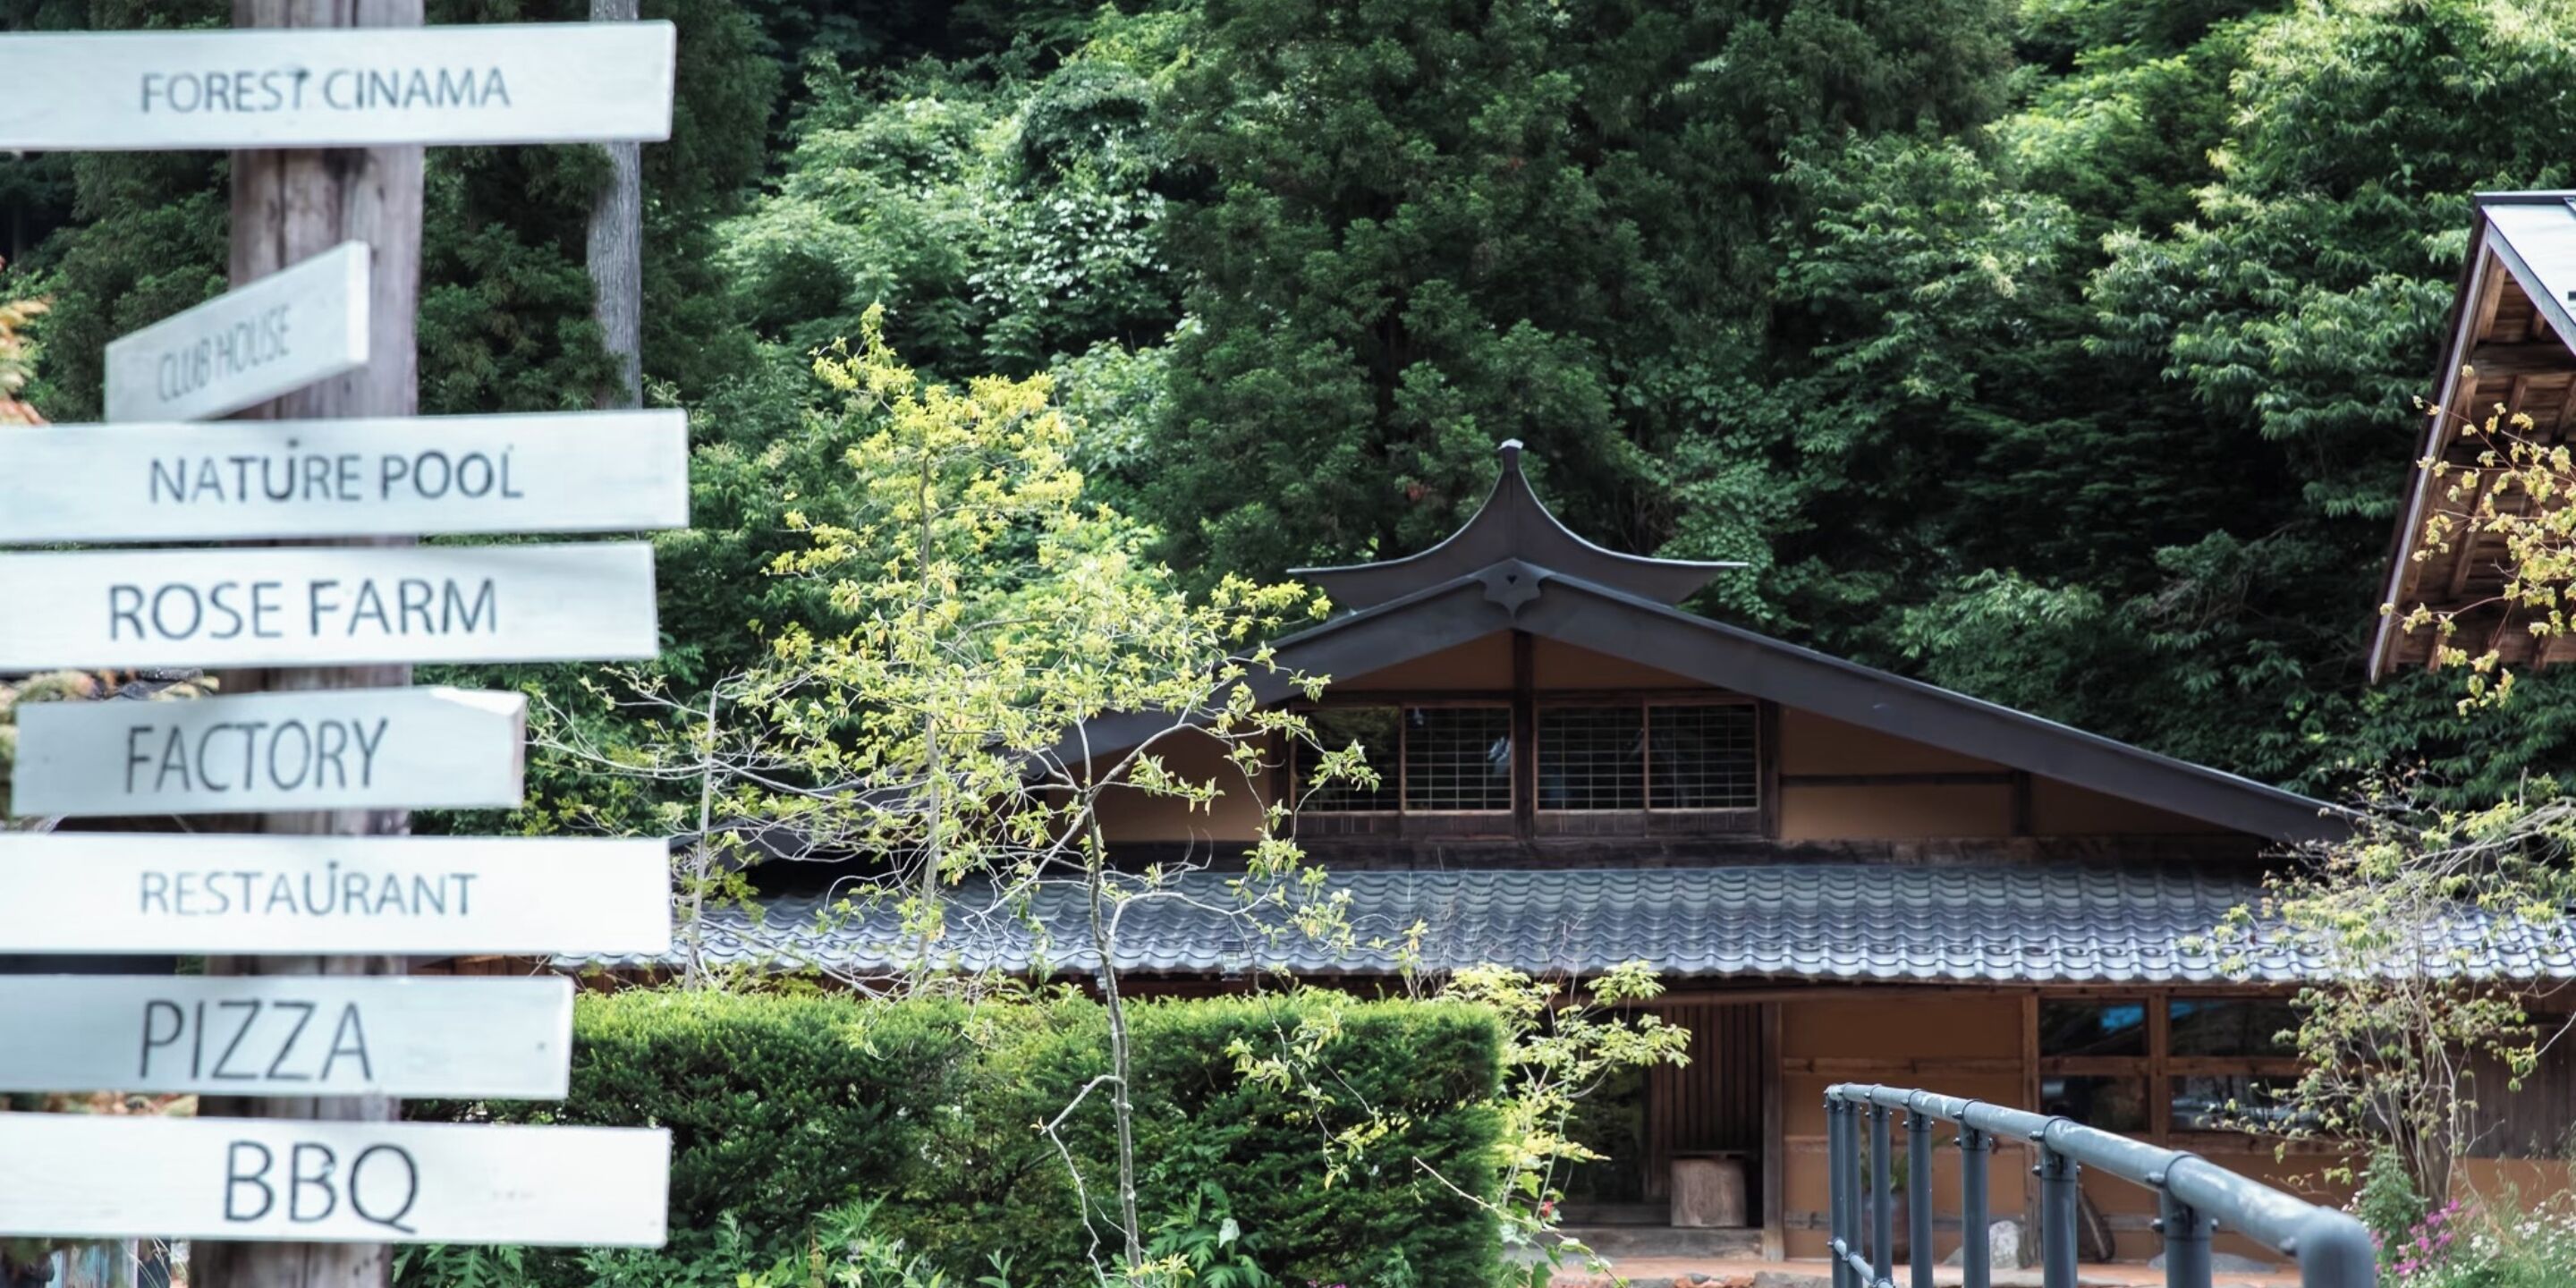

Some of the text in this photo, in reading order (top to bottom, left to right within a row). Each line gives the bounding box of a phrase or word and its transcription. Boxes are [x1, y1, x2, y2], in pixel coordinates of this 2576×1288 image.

[140, 67, 512, 114] FOREST CINAMA
[157, 304, 291, 402] CLUB HOUSE
[149, 450, 523, 503] NATURE POOL
[108, 578, 497, 641] ROSE FARM
[124, 717, 388, 793] FACTORY
[140, 871, 479, 917] RESTAURANT
[139, 998, 373, 1081] PIZZA
[223, 1140, 419, 1233] BBQ
